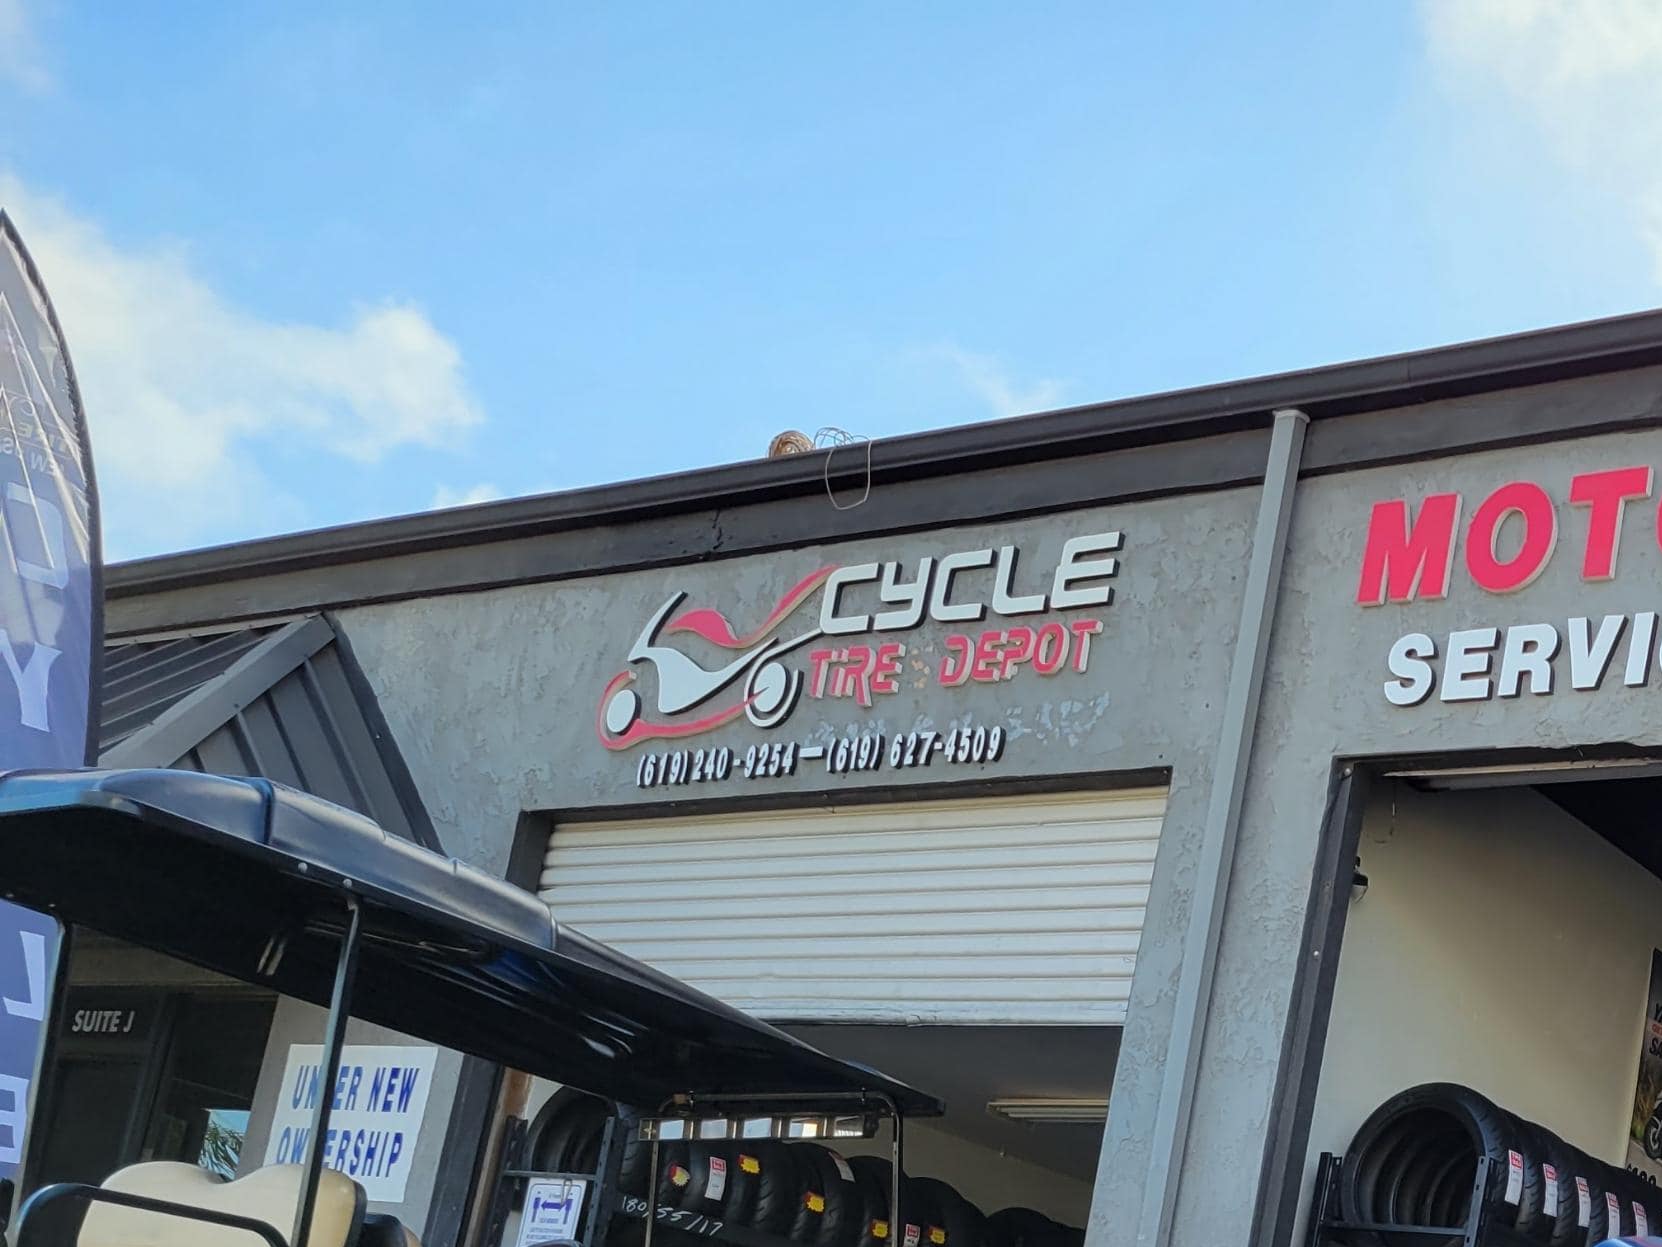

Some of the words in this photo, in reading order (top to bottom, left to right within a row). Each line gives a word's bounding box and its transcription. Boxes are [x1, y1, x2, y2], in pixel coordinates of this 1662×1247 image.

[819, 531, 1124, 634] CYCLE
[809, 643, 906, 707] TIRE
[937, 619, 1103, 687] DEPOT
[72, 1010, 122, 1032] SUITE
[123, 1010, 135, 1032] J
[292, 1065, 363, 1111] UNER
[367, 1067, 420, 1113] NEW
[276, 1125, 404, 1178] OWERSHIP
